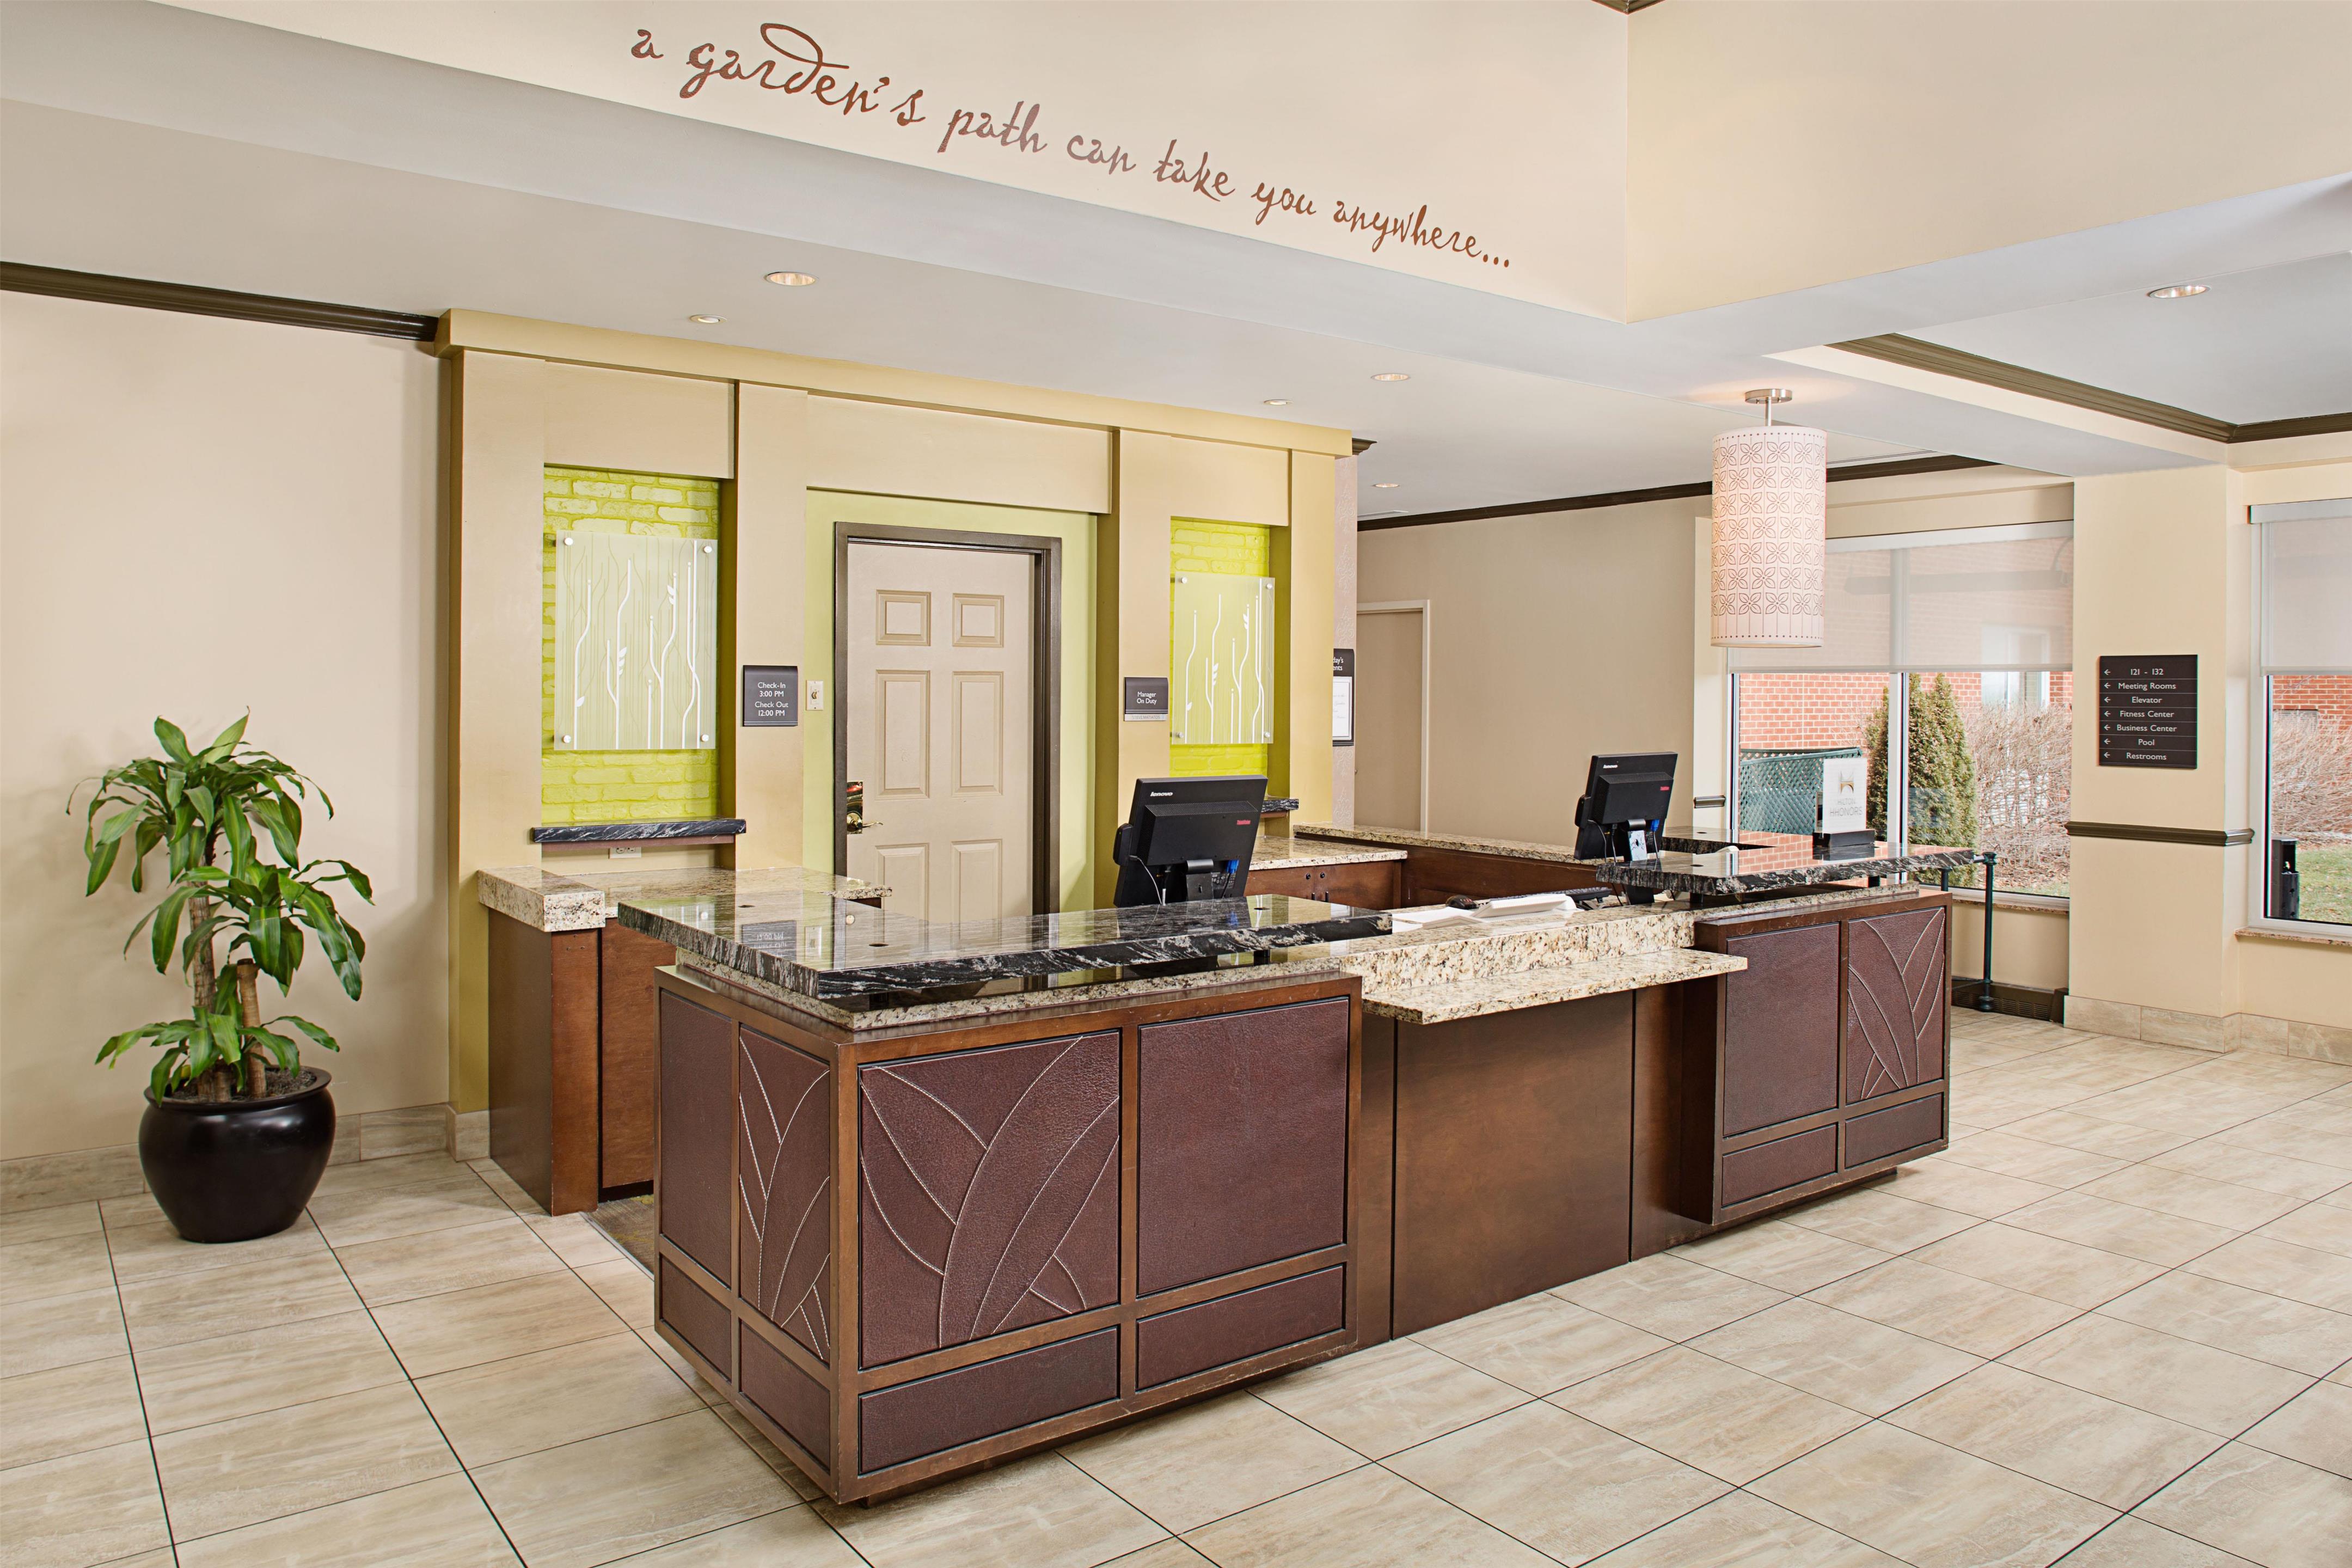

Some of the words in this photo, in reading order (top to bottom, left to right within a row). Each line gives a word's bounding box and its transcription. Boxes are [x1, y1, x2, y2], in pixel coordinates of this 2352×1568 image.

[630, 28, 664, 59] a
[679, 22, 927, 127] garden's
[936, 100, 1049, 154] path
[1067, 134, 1137, 175] can
[1153, 139, 1236, 202] take
[1251, 180, 1317, 226] you
[1333, 204, 1510, 268] anywhere...
[1333, 657, 1344, 665] day's
[2118, 682, 2148, 691] Meeting
